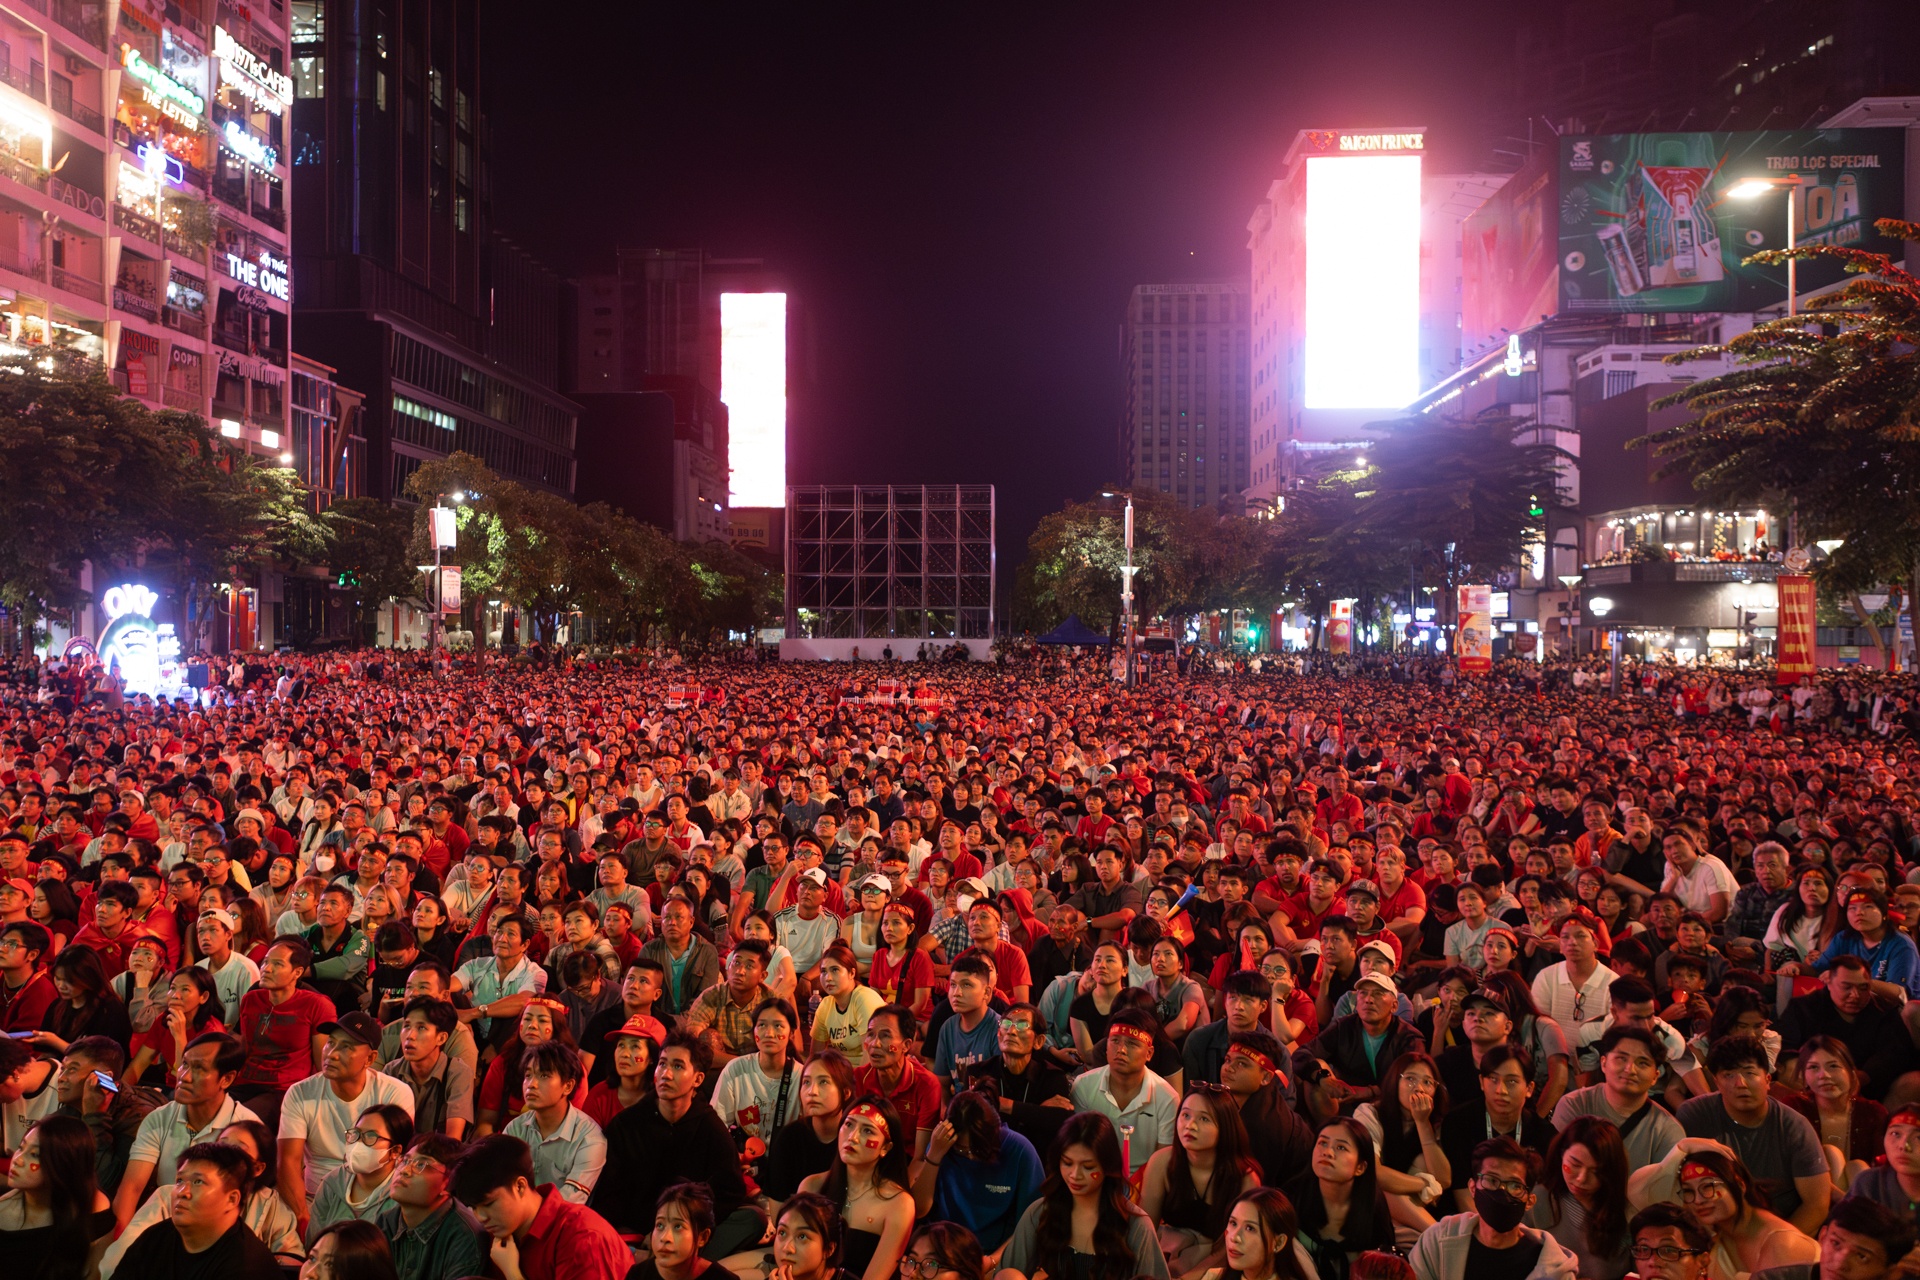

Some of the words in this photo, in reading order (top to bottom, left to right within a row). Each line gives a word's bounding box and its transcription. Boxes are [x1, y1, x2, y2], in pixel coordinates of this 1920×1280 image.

[142, 85, 162, 110] THE
[162, 99, 199, 132] LETTER
[1340, 134, 1381, 151] SAIGON
[1382, 133, 1424, 150] PRINCE
[1765, 156, 1800, 170] TRAO
[1829, 154, 1881, 169] SPECIAL
[227, 252, 257, 287] THE
[260, 269, 289, 301] ONE
